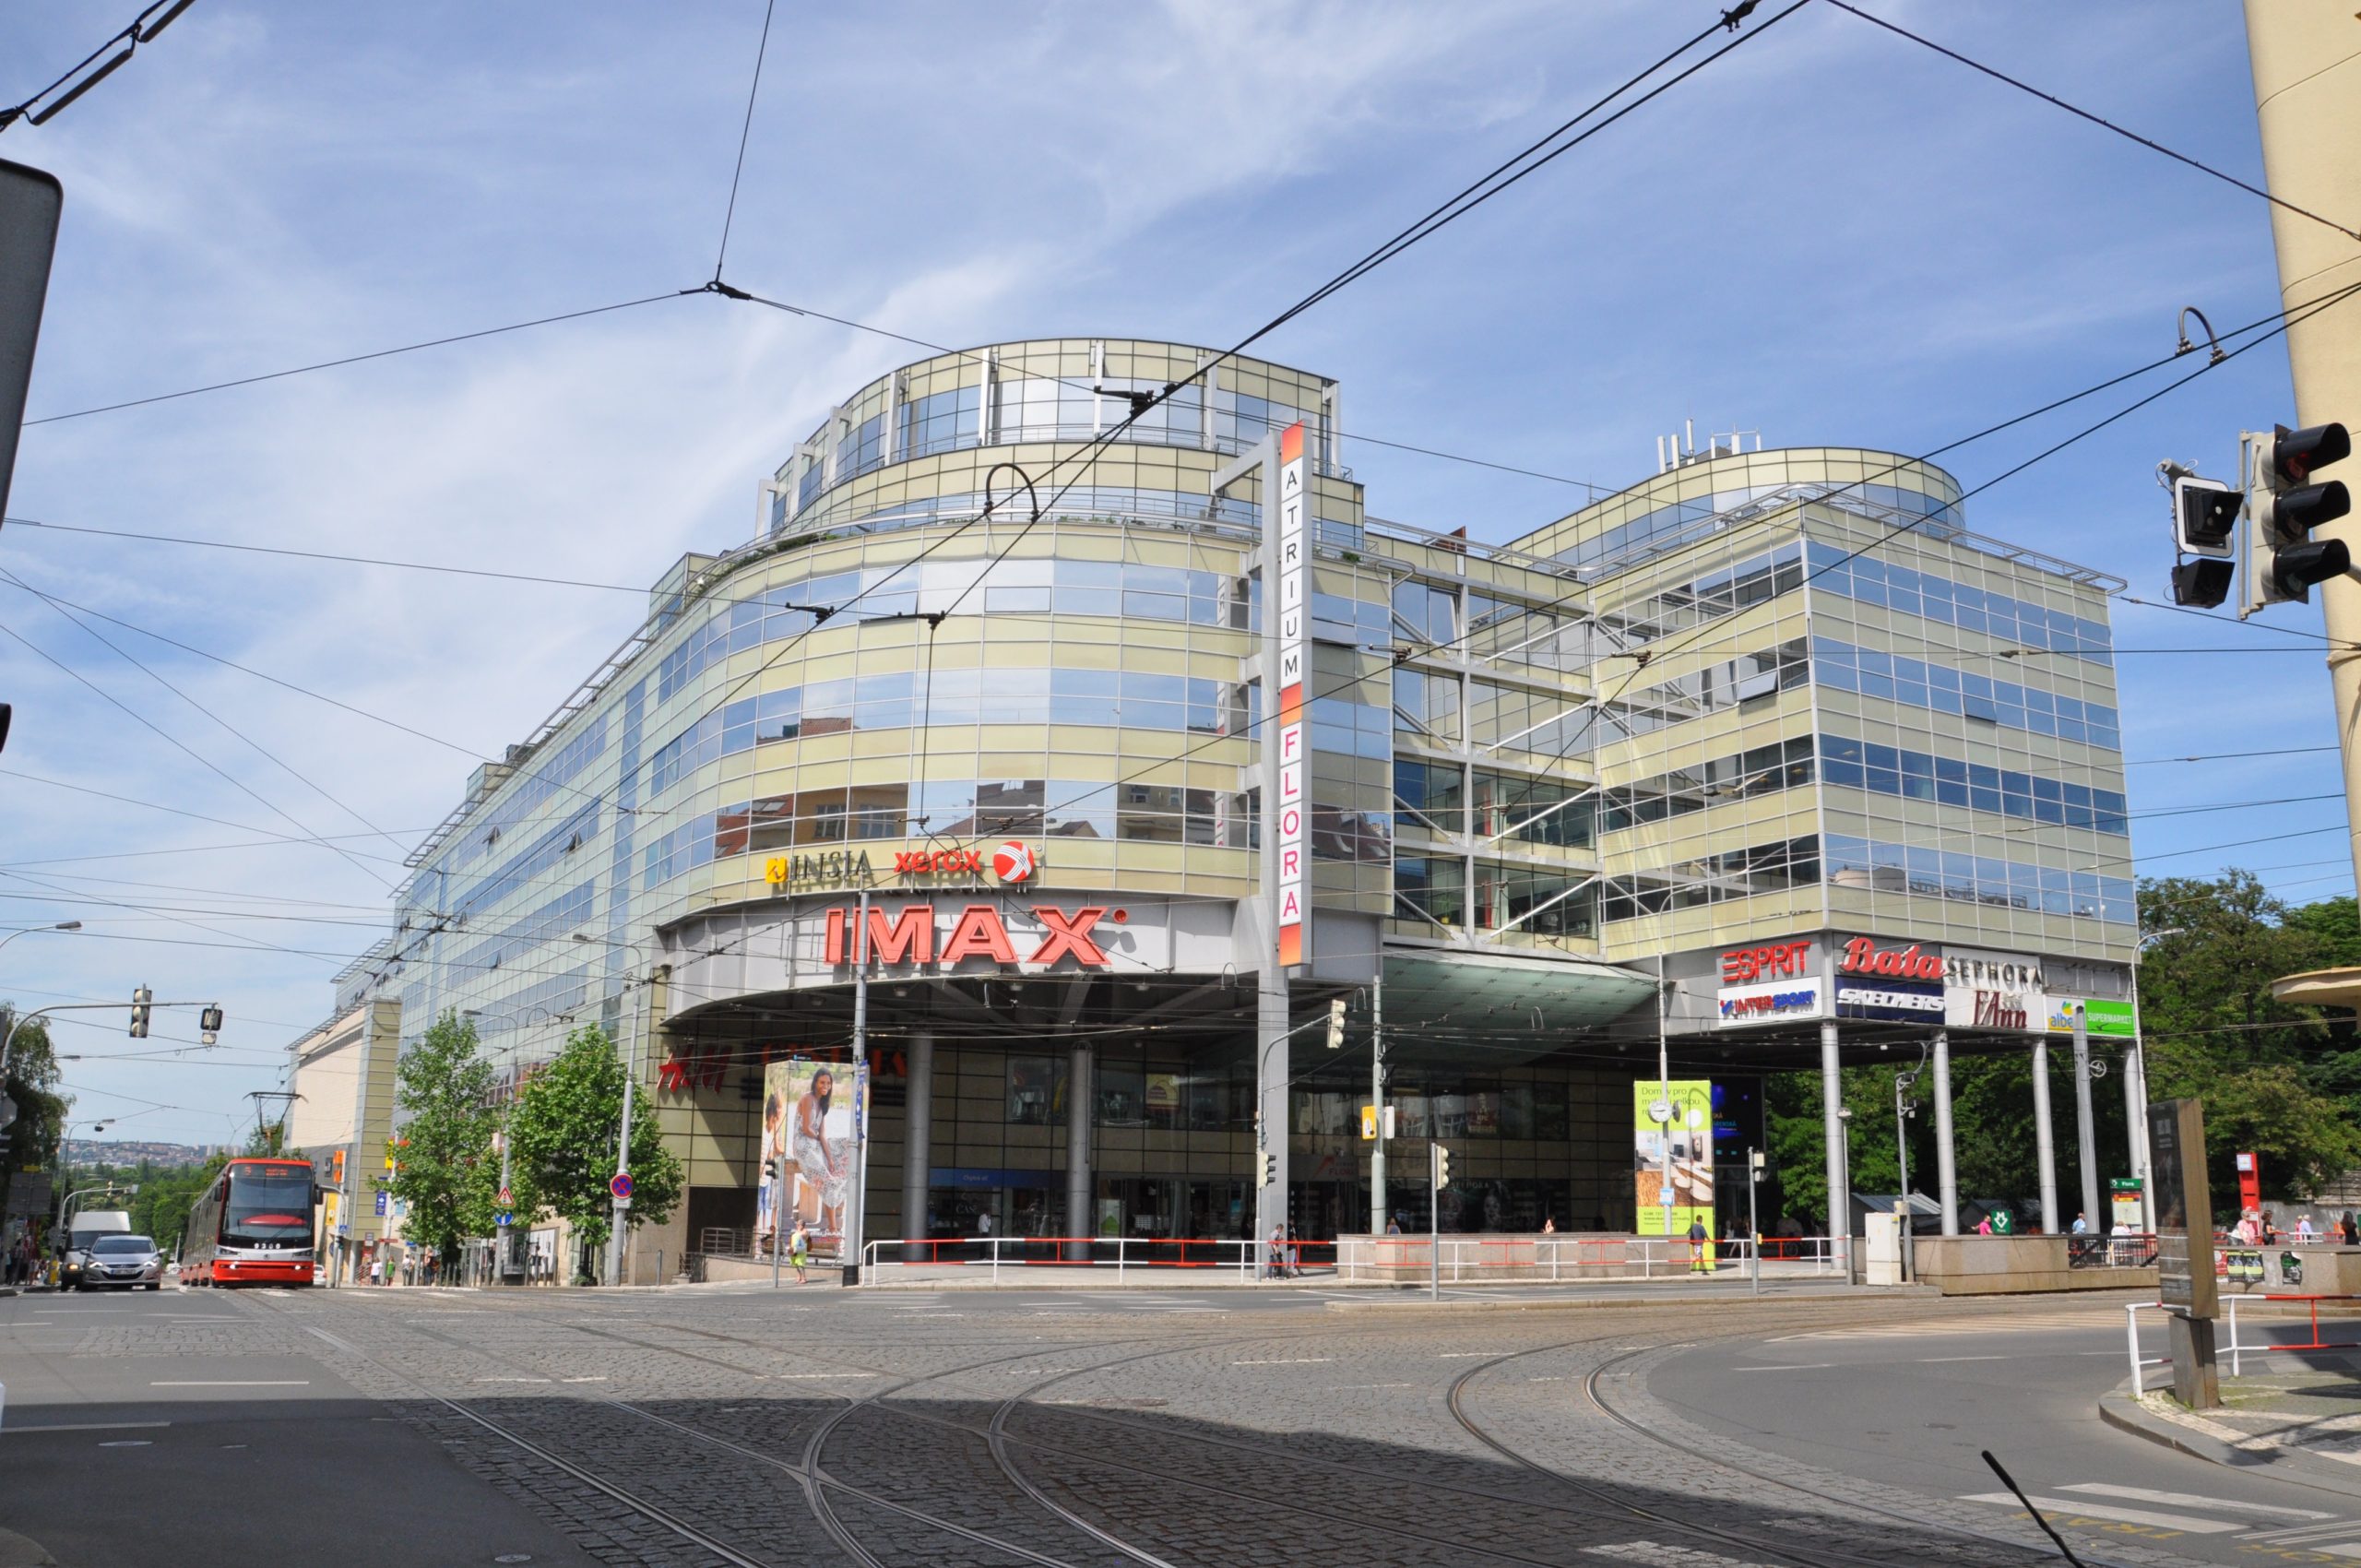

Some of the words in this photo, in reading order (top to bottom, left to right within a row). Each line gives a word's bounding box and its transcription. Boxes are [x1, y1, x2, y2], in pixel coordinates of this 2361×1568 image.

[1285, 469, 1299, 678] ATRIUM
[1283, 730, 1299, 918] FLORA
[790, 849, 872, 881] INSIA
[894, 849, 982, 873] xerox
[824, 904, 1112, 965] IMAX
[1722, 940, 1811, 982] ESPRIT
[1841, 936, 1947, 980] Bata
[1946, 955, 2042, 984] SEPHORA
[1734, 990, 1816, 1013] INTERSPORT
[1836, 988, 1946, 1012] SKECHERS
[2050, 1013, 2073, 1028] albe
[2087, 1012, 2132, 1025] SUPERMARKET
